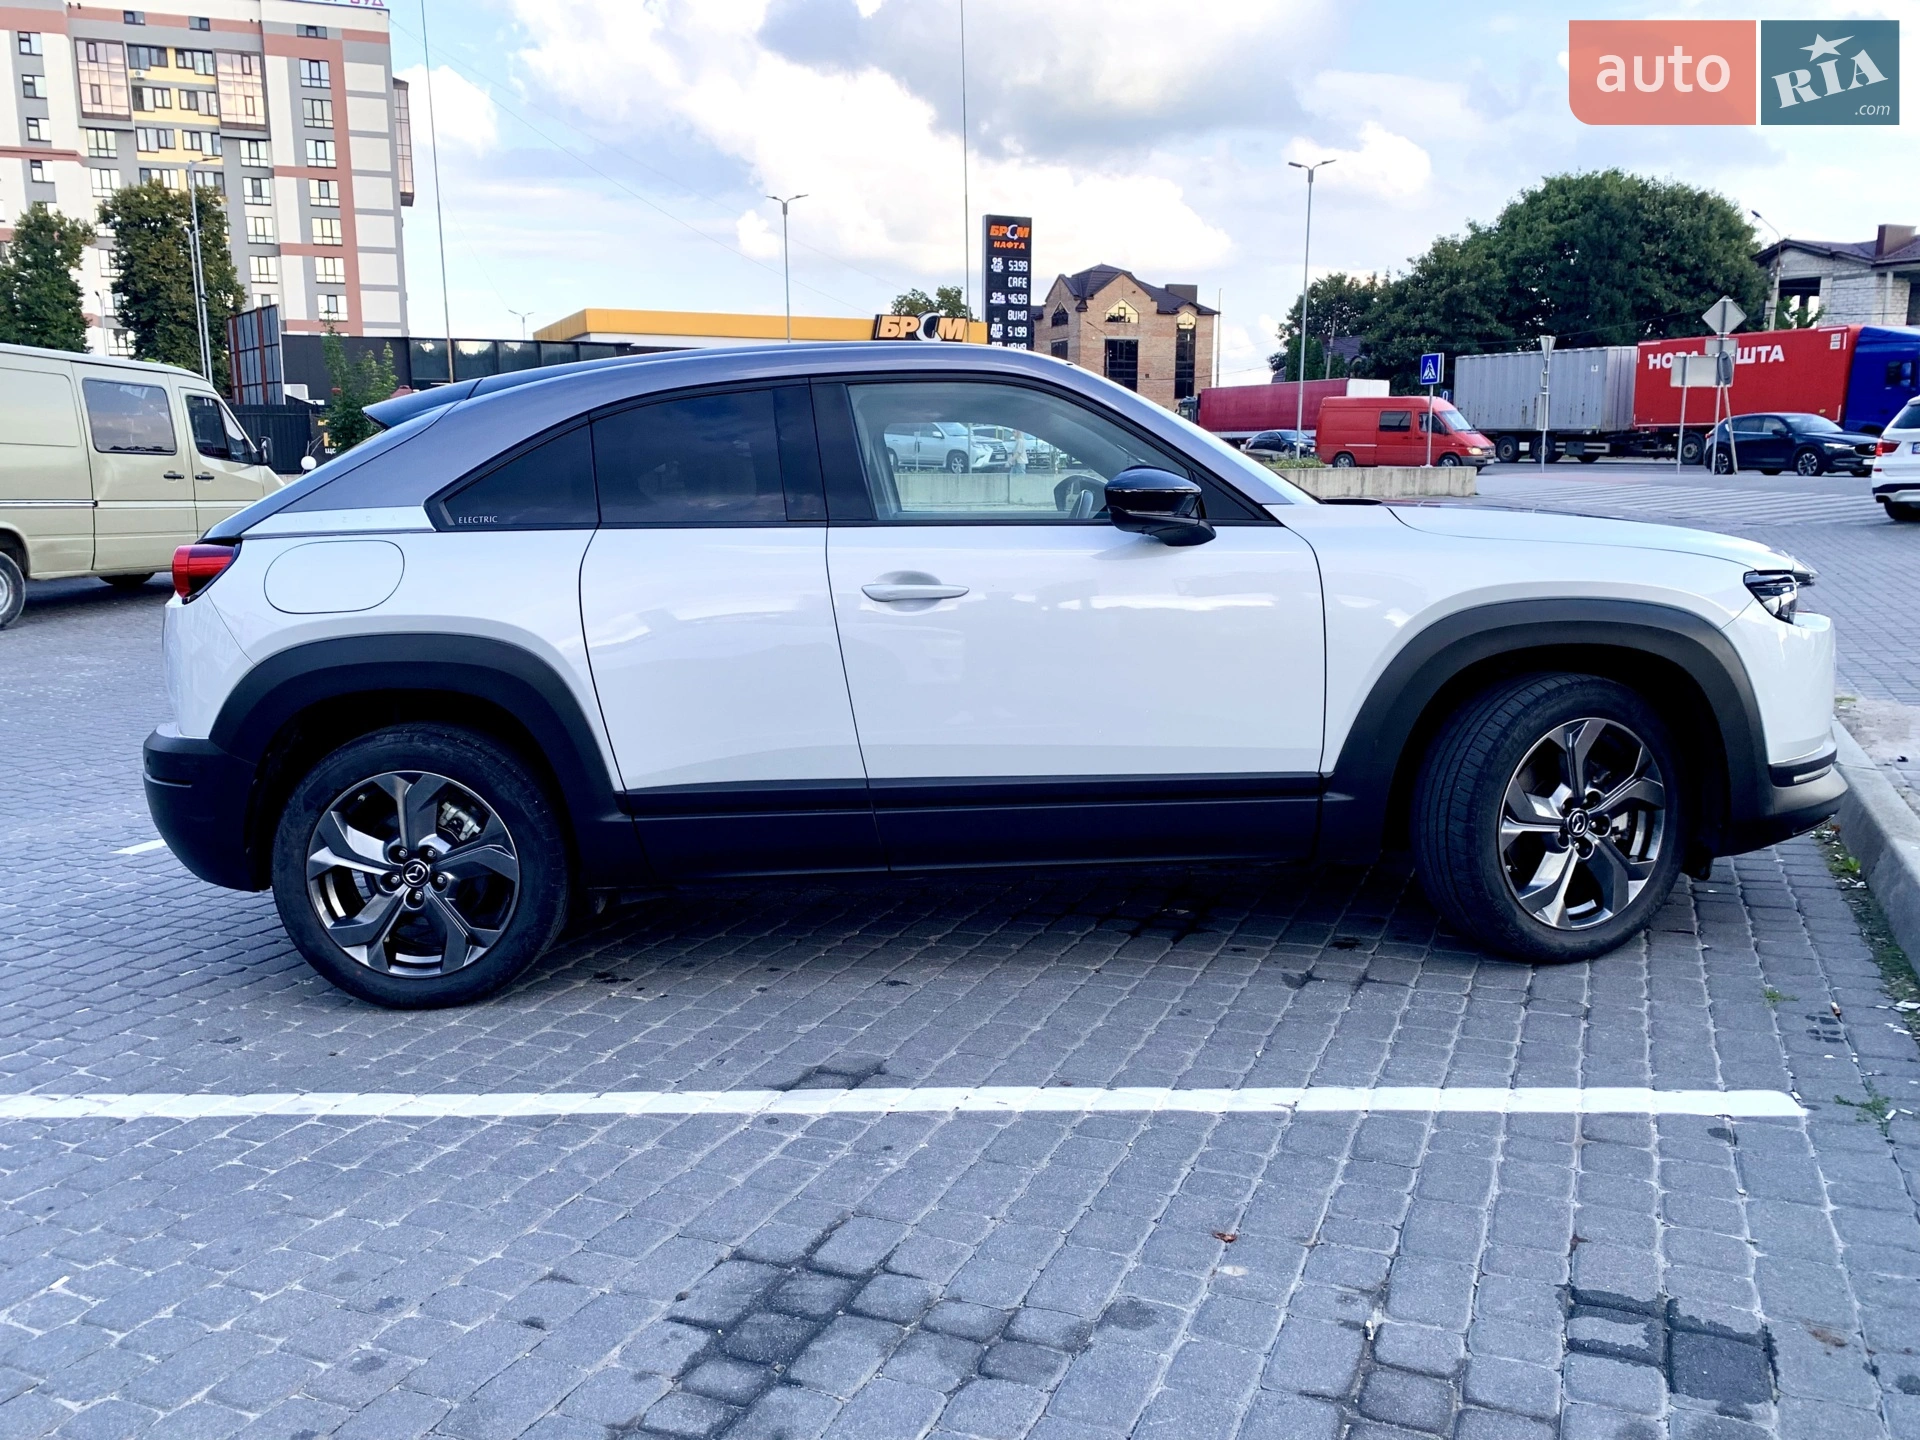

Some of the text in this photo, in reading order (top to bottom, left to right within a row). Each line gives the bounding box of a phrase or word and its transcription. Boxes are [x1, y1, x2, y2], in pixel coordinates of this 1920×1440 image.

[990, 224, 1030, 240] БРСМ
[993, 241, 1025, 249] НАФТА
[878, 311, 967, 341] БРСМ
